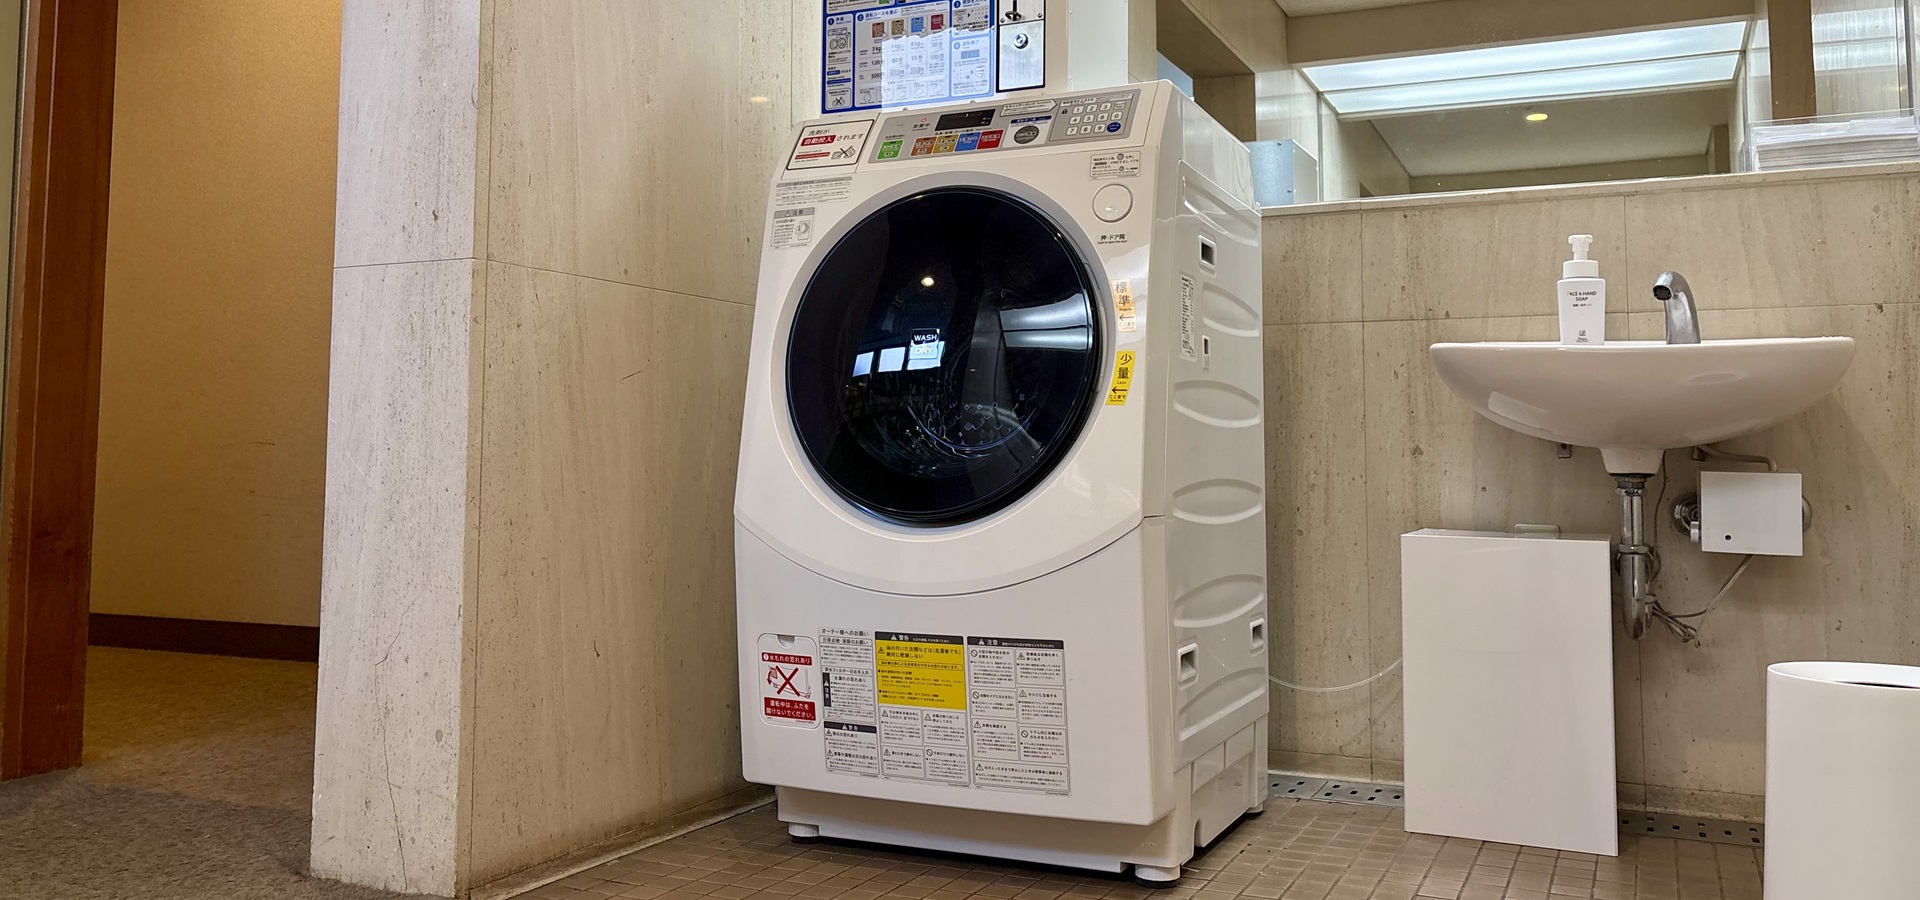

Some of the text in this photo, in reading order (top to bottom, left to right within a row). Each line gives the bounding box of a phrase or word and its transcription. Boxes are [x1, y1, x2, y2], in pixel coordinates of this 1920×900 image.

[803, 133, 864, 145] 自動投入 されます
[1115, 282, 1130, 306] 標準
[1117, 352, 1132, 379] 少量
[821, 628, 869, 637] オーナー様へのお願い
[898, 634, 909, 642] 警告
[769, 654, 811, 664] 水もれの恐れあり
[769, 700, 810, 710] 運転中は、ふたを
[766, 707, 815, 719] 開けないでください。
